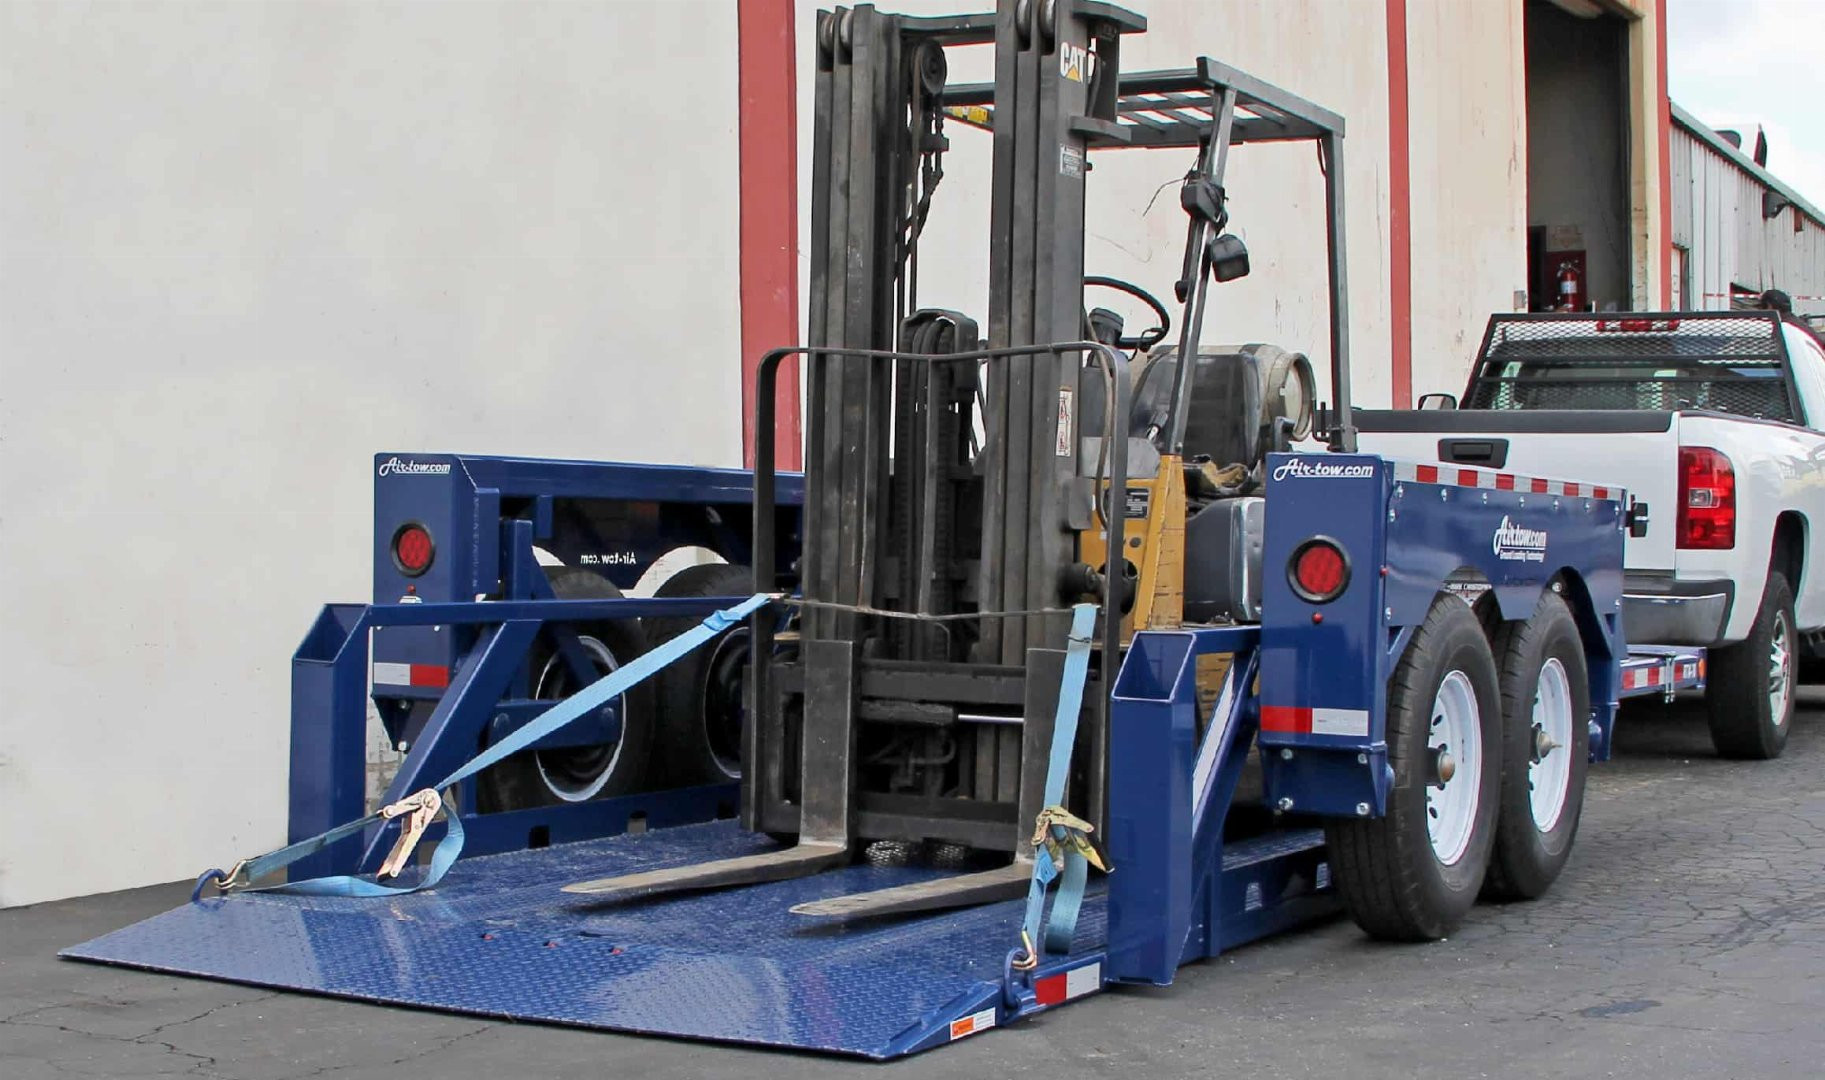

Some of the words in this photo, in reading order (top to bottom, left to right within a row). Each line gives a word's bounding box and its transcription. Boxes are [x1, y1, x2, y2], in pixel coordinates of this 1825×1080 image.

[1060, 42, 1085, 84] CAT
[378, 457, 451, 476] Air-tow.com
[1273, 458, 1374, 481] Air-tow.com
